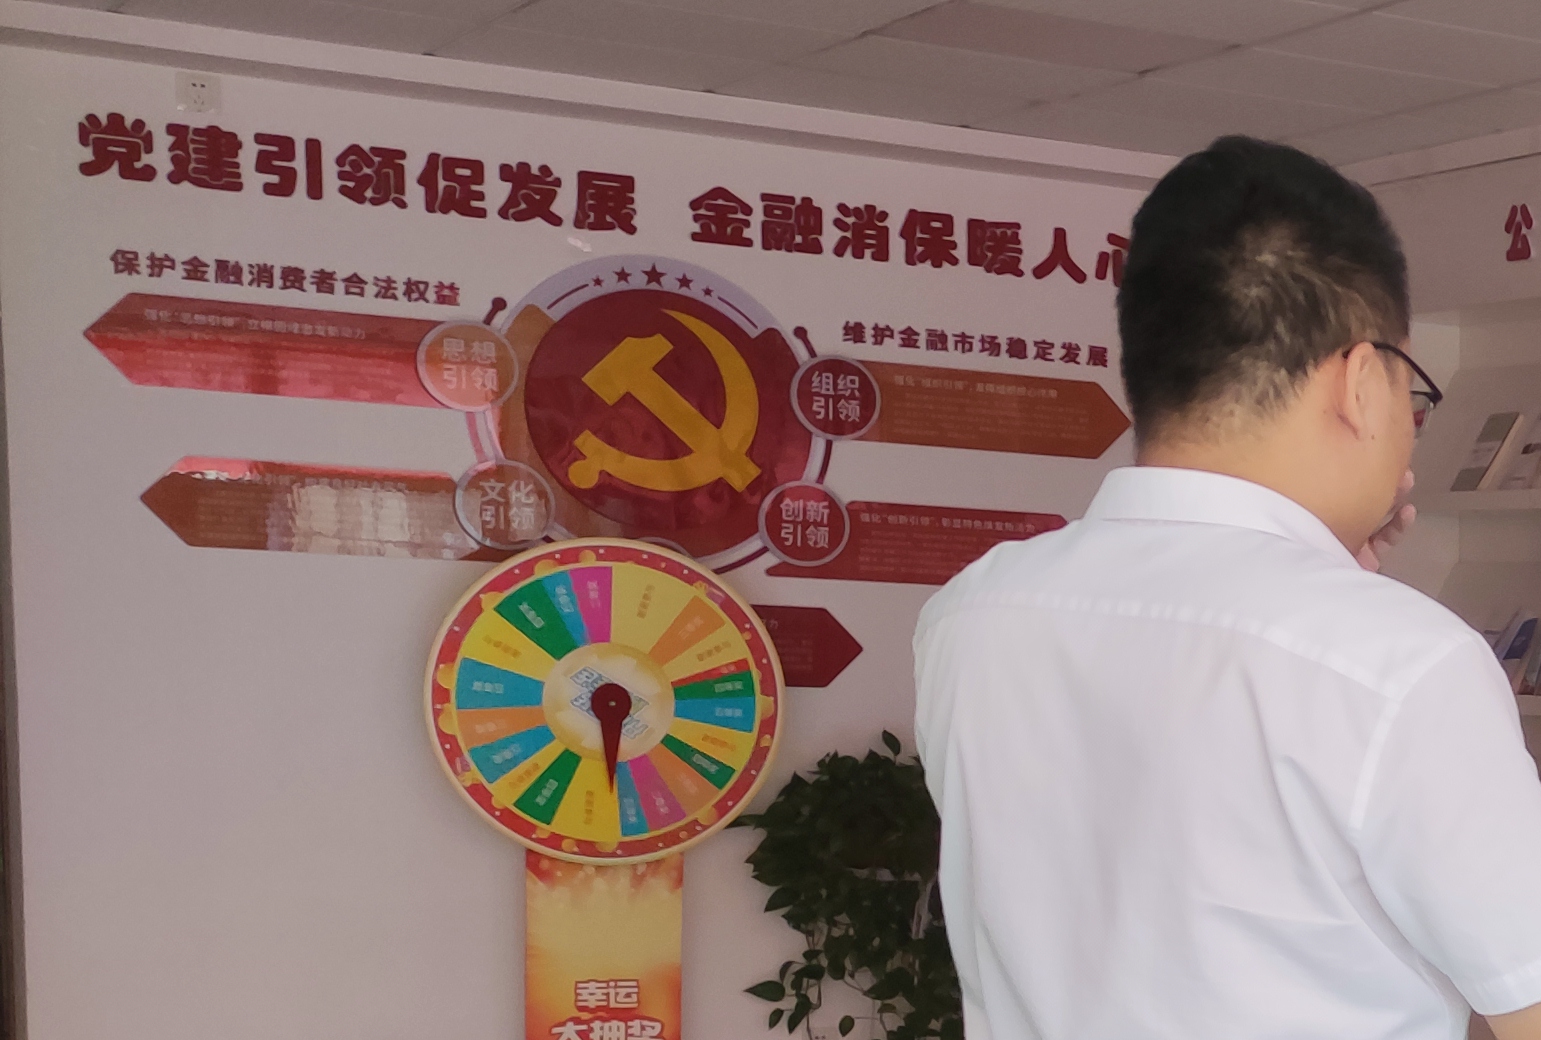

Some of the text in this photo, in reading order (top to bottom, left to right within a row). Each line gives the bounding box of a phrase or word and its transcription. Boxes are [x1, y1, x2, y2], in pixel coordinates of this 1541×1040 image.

[78, 113, 637, 235] 党建引领促发展
[109, 249, 461, 307] 保护金融消费者合法权益
[442, 338, 498, 365] 思想
[842, 321, 1109, 368] 维护金融市场稳定发展
[442, 366, 498, 392] 引领
[811, 371, 860, 397] 组织
[812, 397, 860, 424] 引领
[480, 479, 534, 505] 文化
[481, 505, 535, 530] 引领
[780, 498, 830, 524] 创新
[780, 524, 830, 550] 引领
[576, 980, 639, 1008] 幸运
